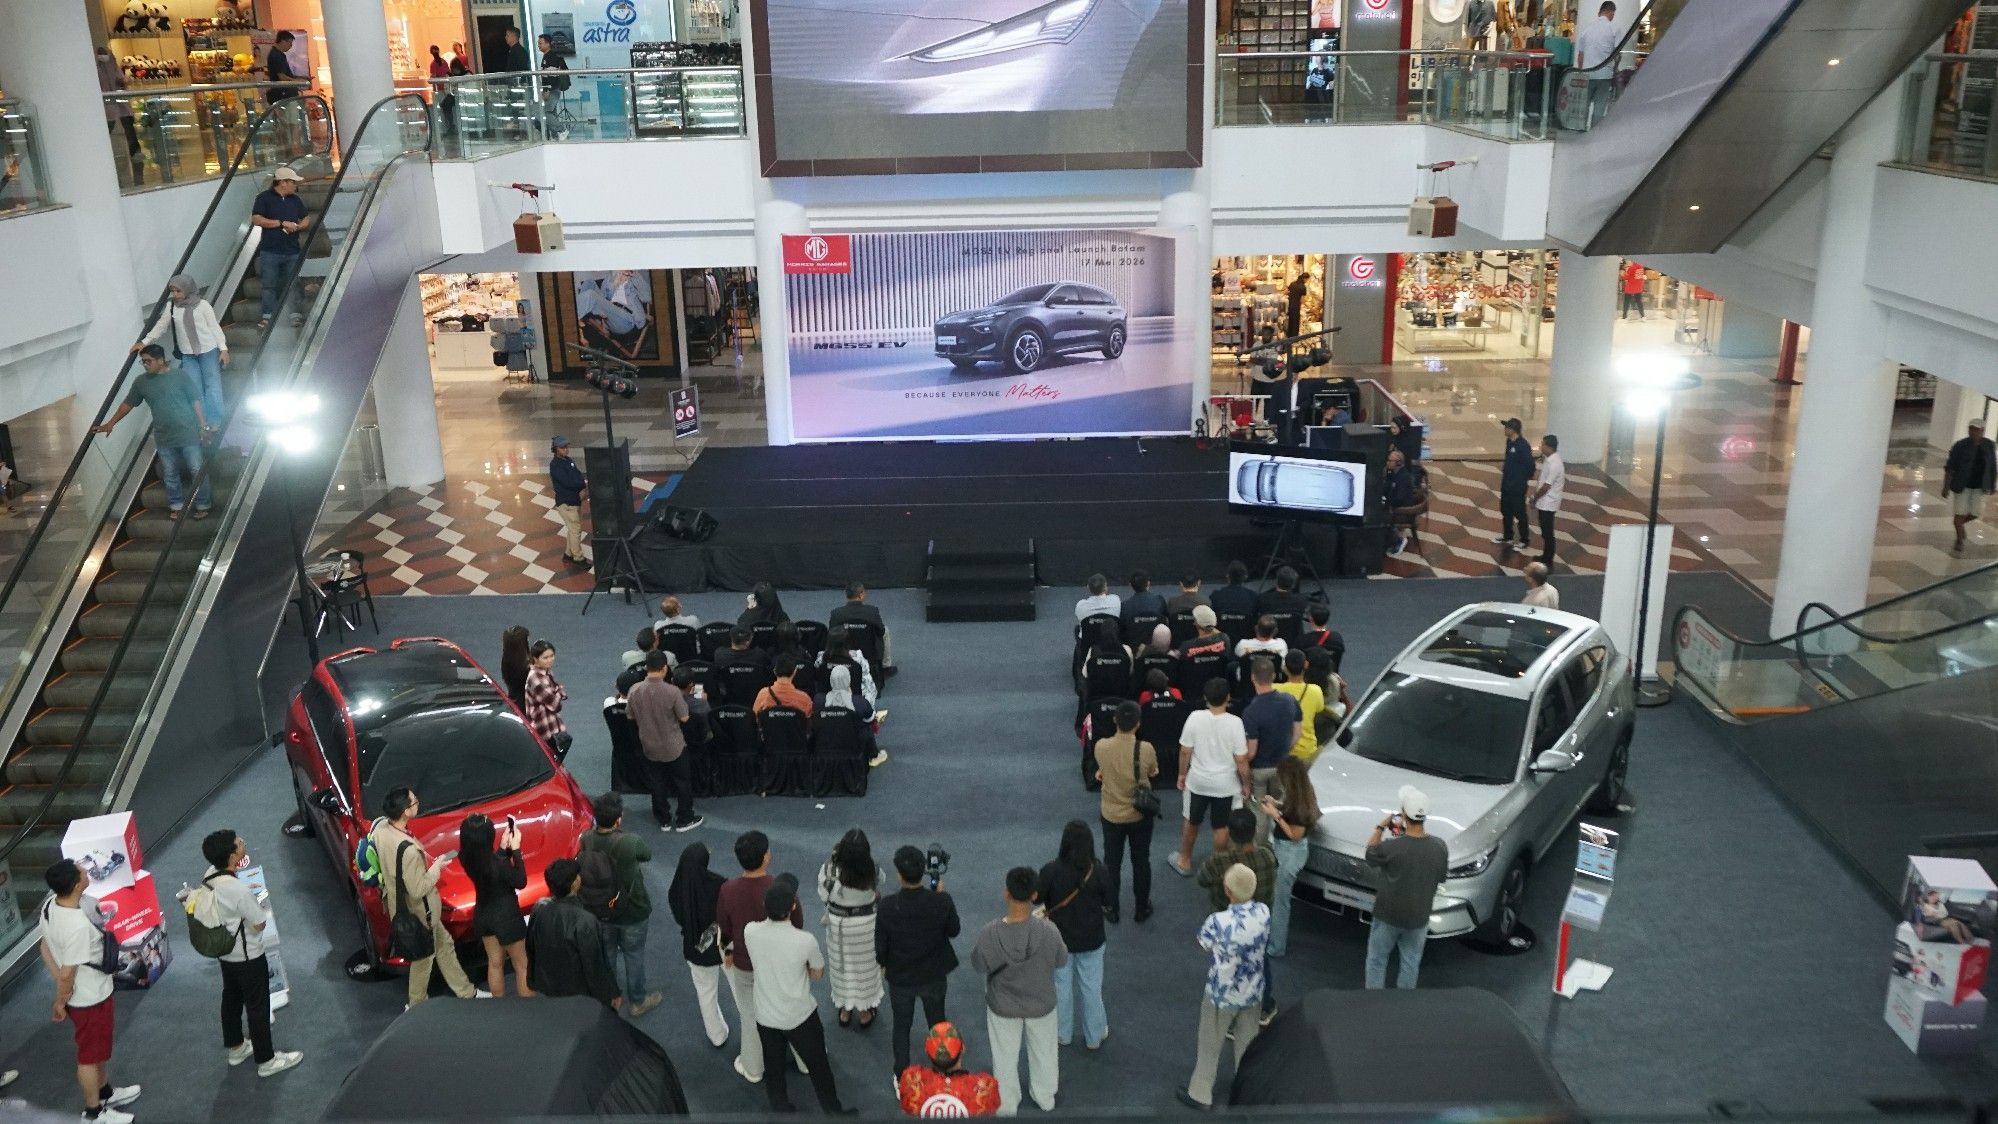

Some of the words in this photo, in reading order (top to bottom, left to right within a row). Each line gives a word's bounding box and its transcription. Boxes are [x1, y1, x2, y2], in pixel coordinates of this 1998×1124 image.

[583, 23, 630, 43] astra
[806, 239, 826, 259] MG
[1112, 244, 1145, 252] Batam
[1081, 259, 1090, 267] 17
[1120, 257, 1145, 266] 2026
[878, 341, 910, 349] EV
[1005, 383, 1061, 399] Matters
[113, 907, 153, 930] REAR-WHEEL
[125, 917, 144, 931] DRIVE
